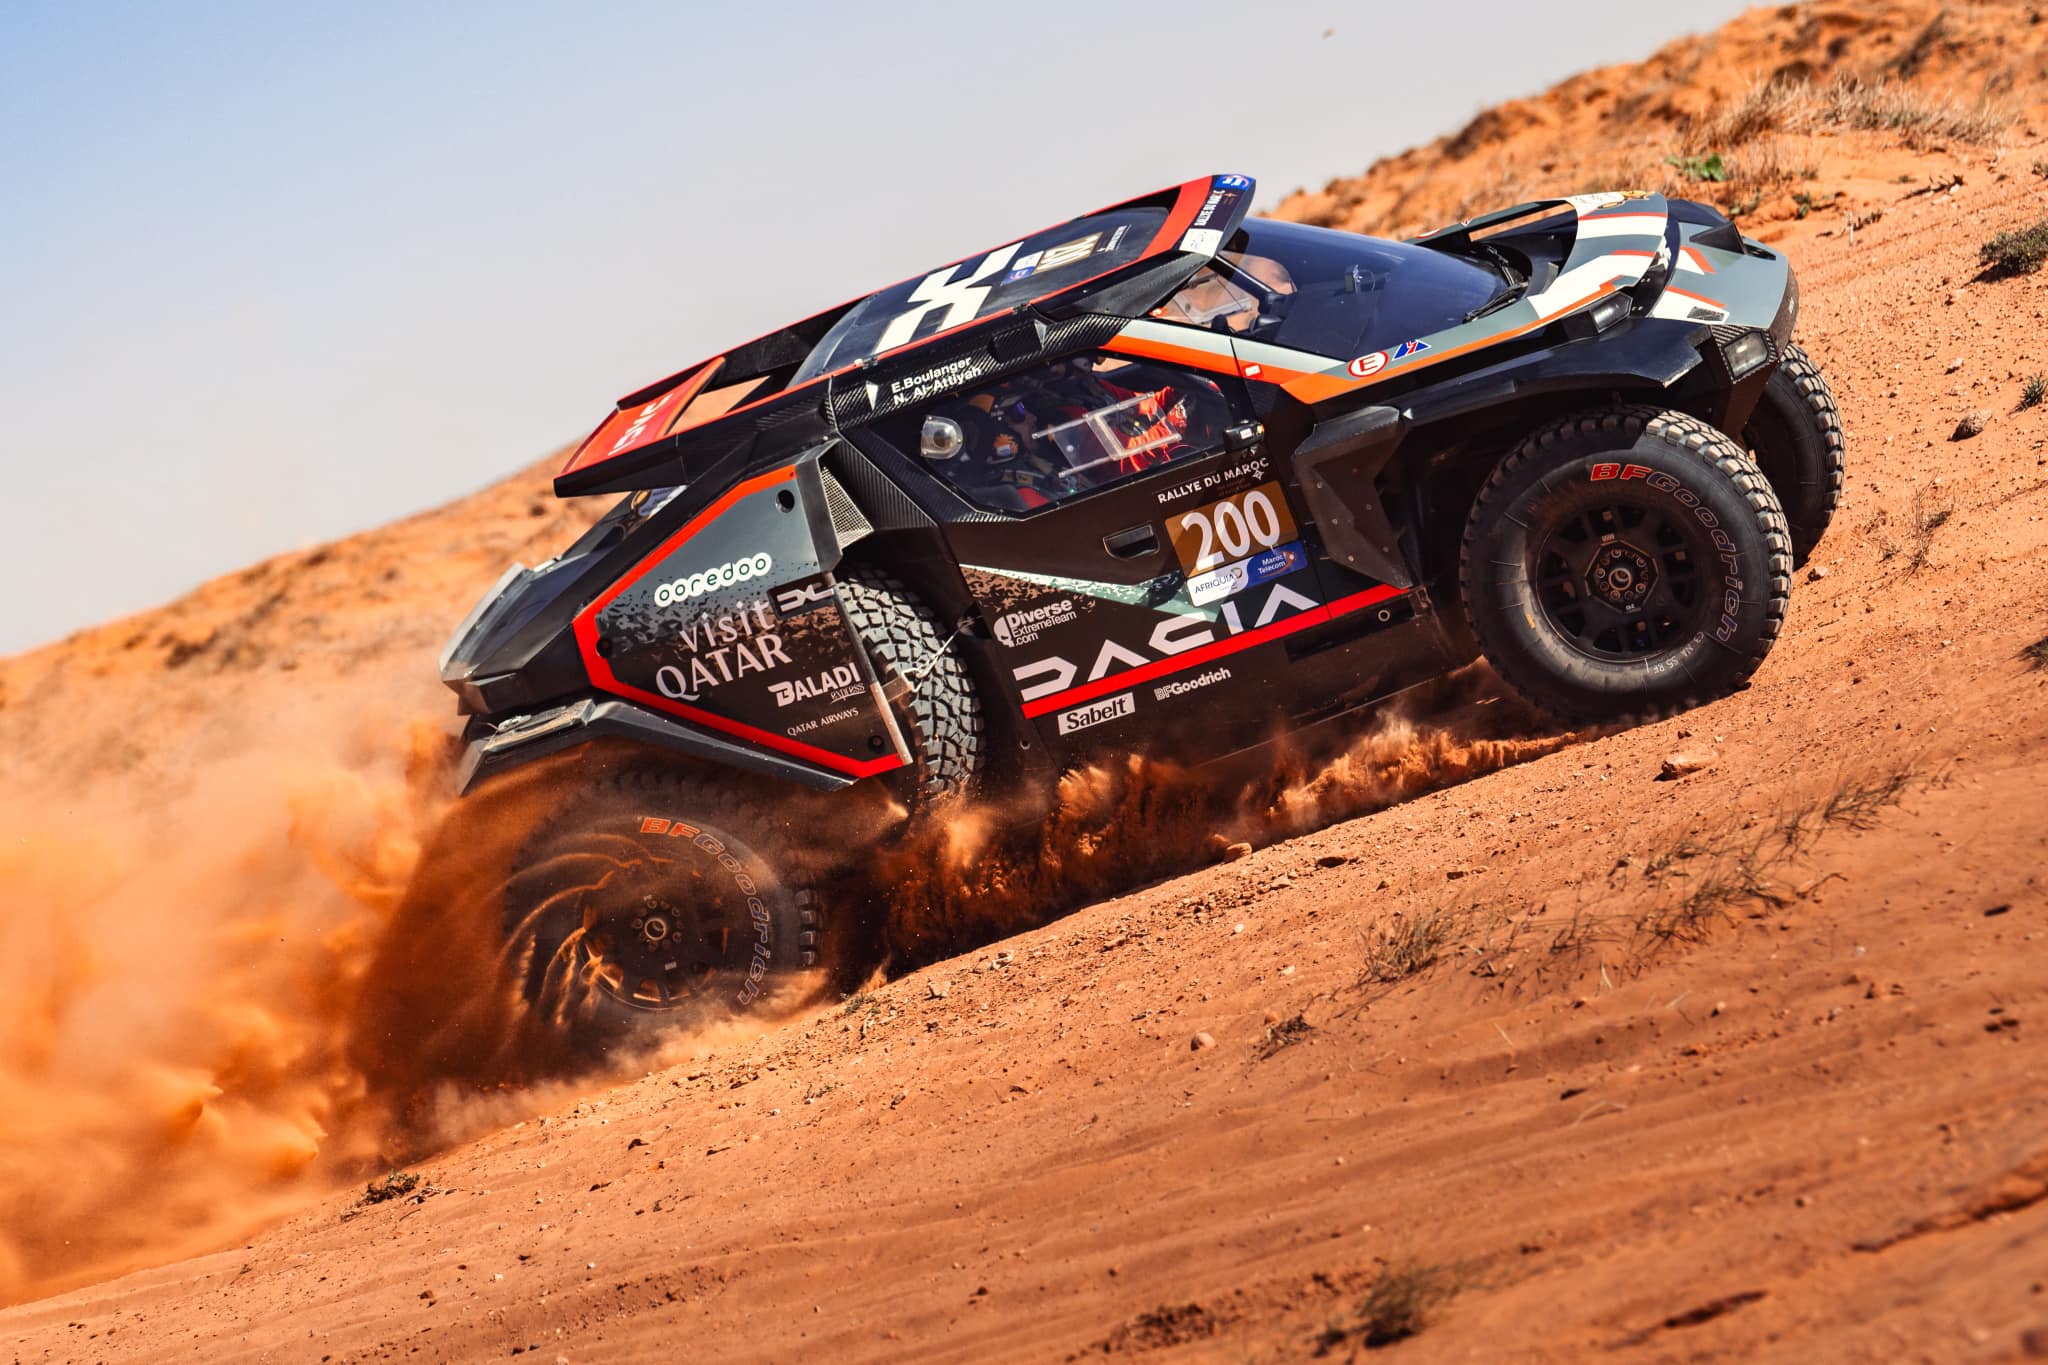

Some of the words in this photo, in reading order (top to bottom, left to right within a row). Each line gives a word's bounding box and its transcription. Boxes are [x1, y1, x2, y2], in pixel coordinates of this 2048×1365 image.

[891, 357, 972, 394] E.Boulanger
[893, 392, 909, 406] N.
[913, 366, 982, 399] Al-Attiyah
[1157, 480, 1202, 504] RALLYE
[1204, 474, 1221, 488] DU
[1223, 457, 1269, 481] MAROC
[1181, 490, 1280, 571] 200
[1258, 560, 1286, 576] Telecom
[1262, 554, 1284, 566] Maroc
[1590, 462, 1744, 642] BFGoodrich
[657, 554, 768, 602] ooredoo
[1194, 572, 1237, 594] AFRIQUIA
[680, 599, 775, 653] visit
[1007, 599, 1073, 629] Diverse
[1011, 609, 1077, 638] ExtremeTeam
[1012, 583, 1321, 702] DACIA
[1014, 631, 1039, 647] .com
[655, 633, 793, 702] QATAR
[767, 662, 861, 707] BALADI
[1154, 667, 1232, 701] BFGoodrich
[787, 720, 818, 736] QATAR
[820, 707, 859, 726] AIRWAYS
[1066, 699, 1127, 731] Sabelt
[639, 816, 772, 1006] BFGoodrich
